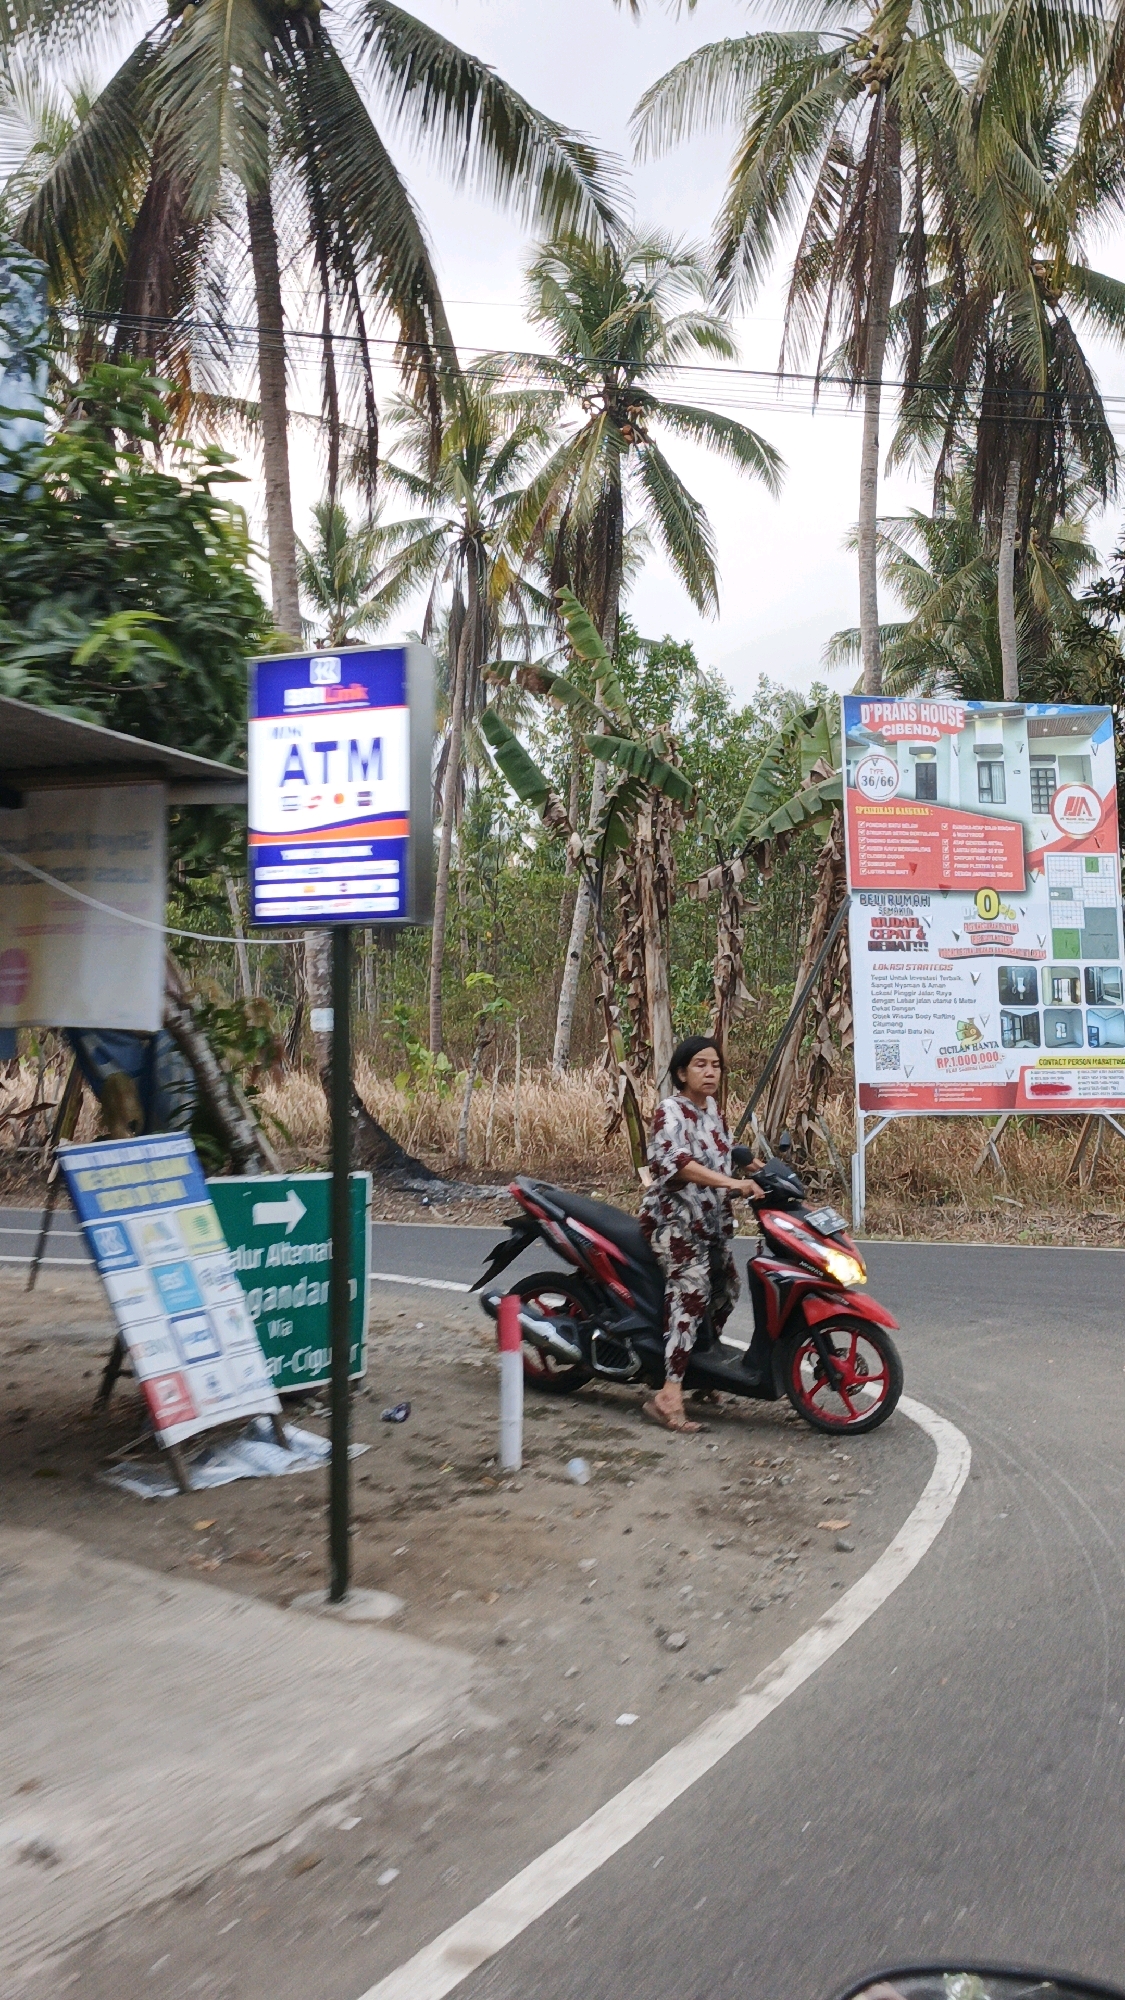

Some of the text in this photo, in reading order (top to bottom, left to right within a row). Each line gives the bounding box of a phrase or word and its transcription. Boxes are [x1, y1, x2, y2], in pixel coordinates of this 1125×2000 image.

[860, 703, 965, 728] D'PRANS HOUSE
[882, 723, 941, 737] CIBENDA
[279, 737, 384, 787] ATM
[861, 776, 894, 789] 36/66
[860, 893, 931, 907] BELI RUMAH
[870, 928, 926, 940] CEPAT &
[972, 1041, 999, 1052] HANYA
[229, 1238, 333, 1271] alur Alternat
[267, 1318, 293, 1339] Via
